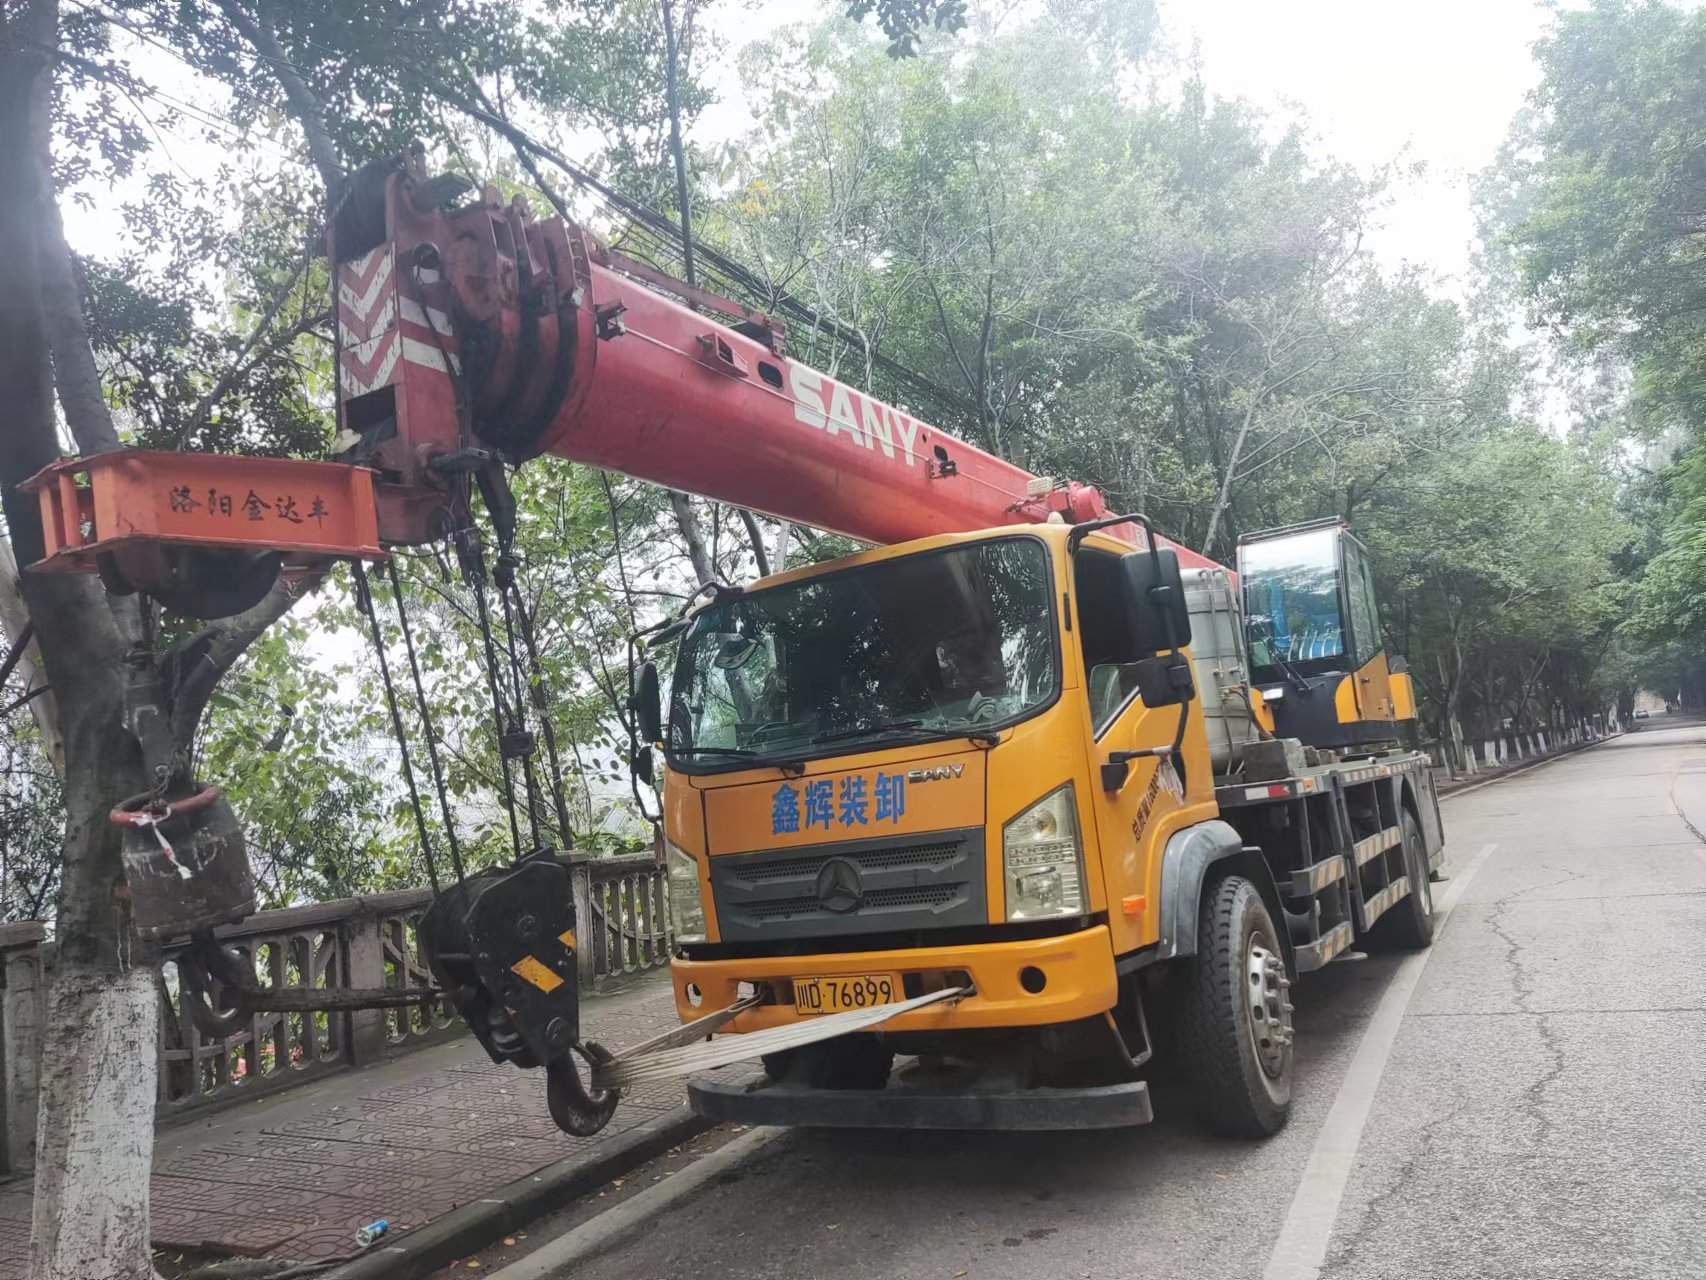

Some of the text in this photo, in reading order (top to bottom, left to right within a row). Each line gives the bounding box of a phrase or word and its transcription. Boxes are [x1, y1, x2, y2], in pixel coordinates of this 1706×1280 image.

[790, 360, 918, 467] SANY
[771, 772, 905, 836] 鑫辉装卸
[907, 763, 966, 784] SANY
